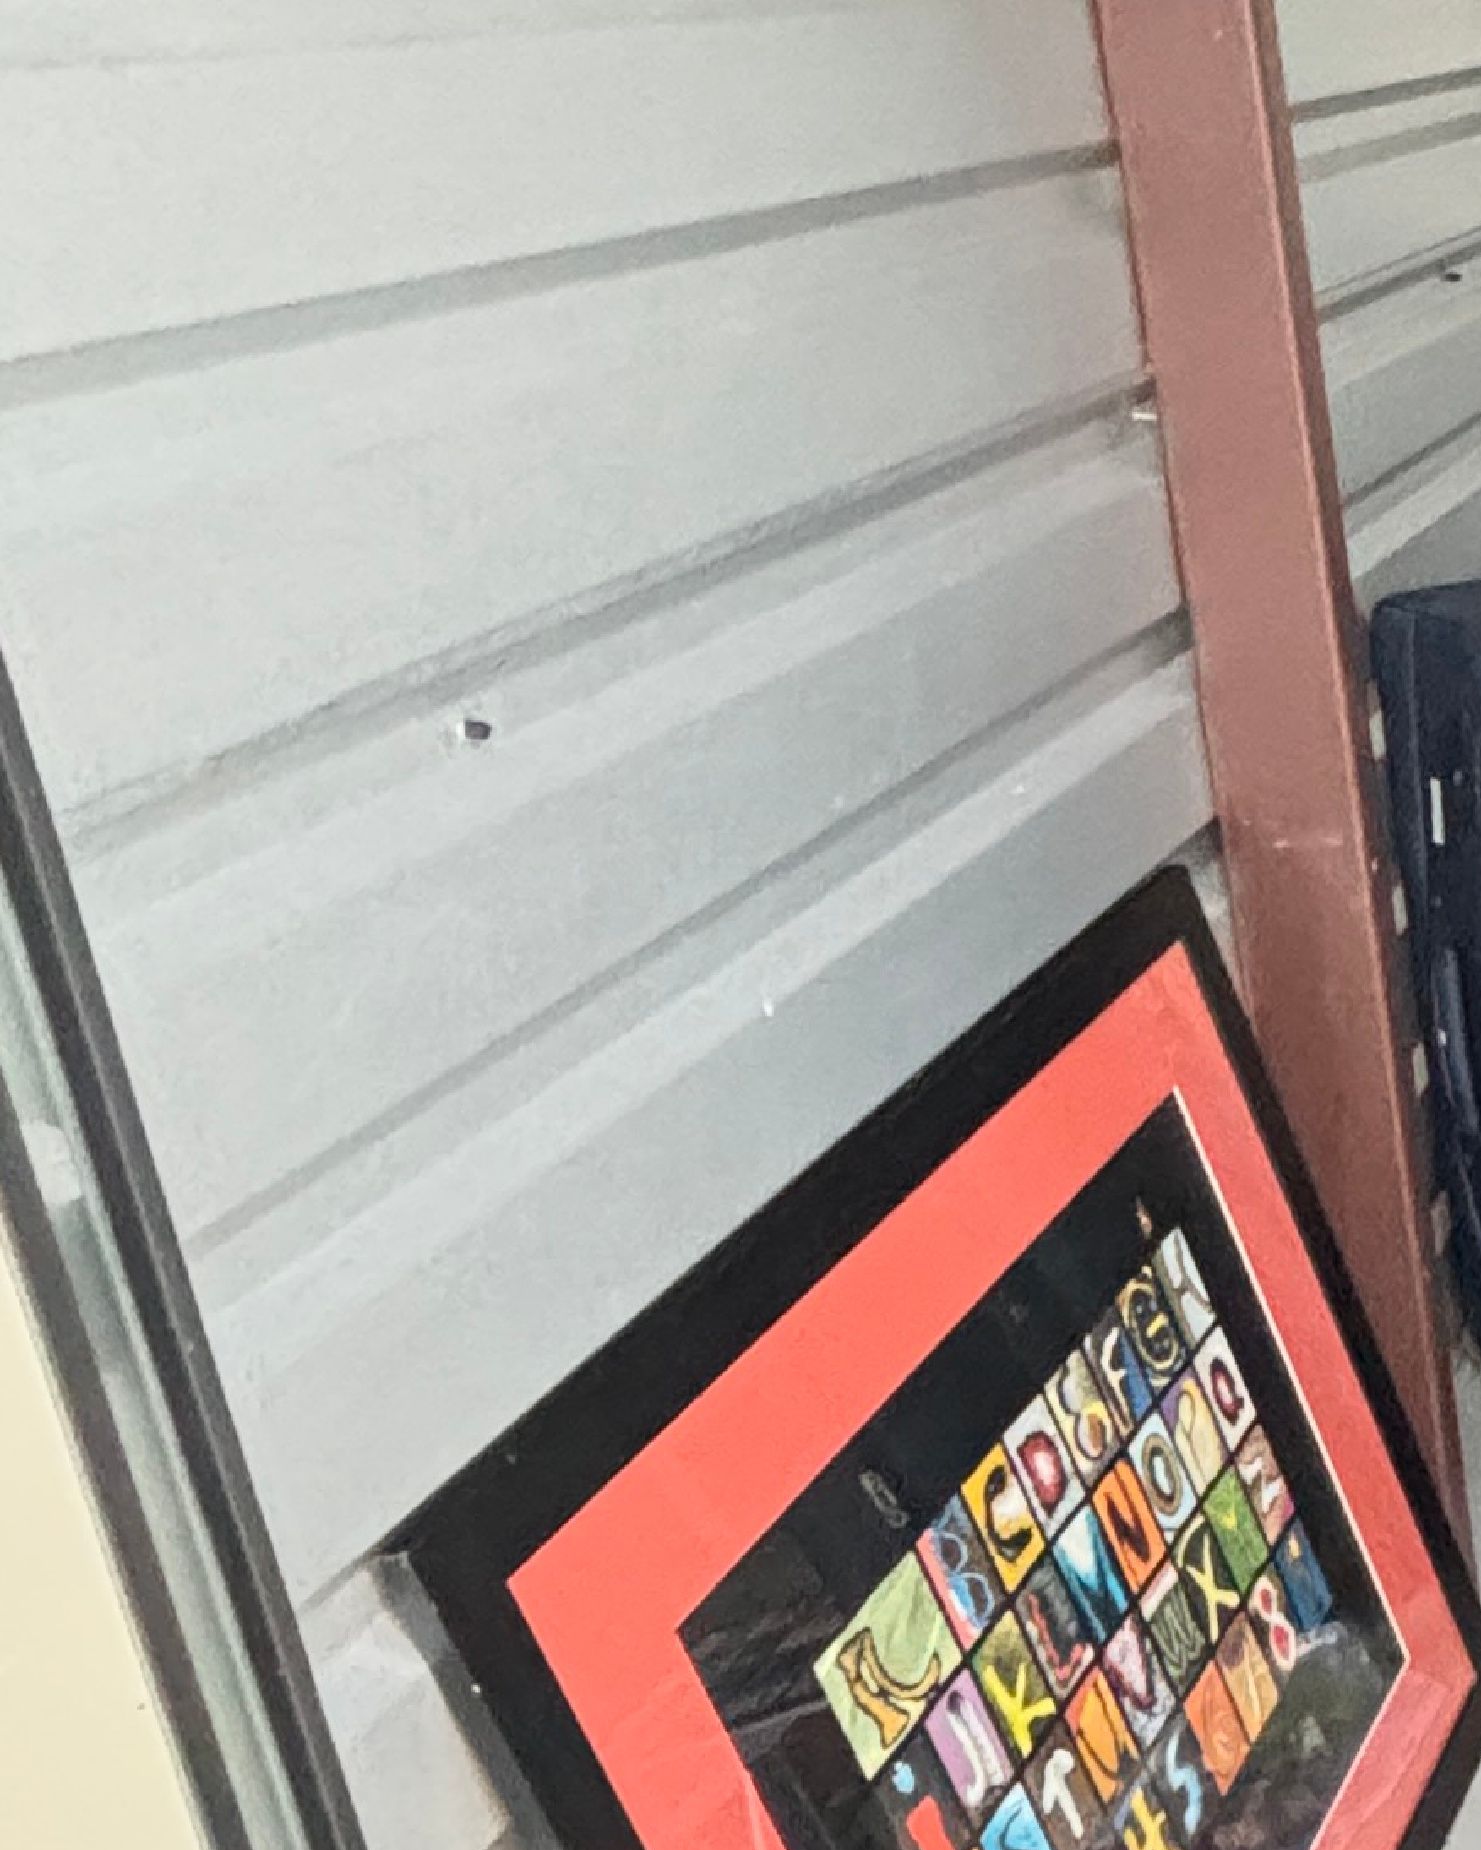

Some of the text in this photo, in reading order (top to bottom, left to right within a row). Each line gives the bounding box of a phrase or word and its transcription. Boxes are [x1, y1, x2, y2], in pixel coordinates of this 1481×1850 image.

[984, 1661, 1057, 1757] K
[1141, 1433, 1184, 1517] O
[1211, 1357, 1245, 1426] Q
[985, 1463, 1034, 1561] C
[1017, 1431, 1064, 1506] D
[1185, 1533, 1241, 1643] X
[1166, 1727, 1203, 1835] 5
[1251, 1576, 1297, 1672] 8
